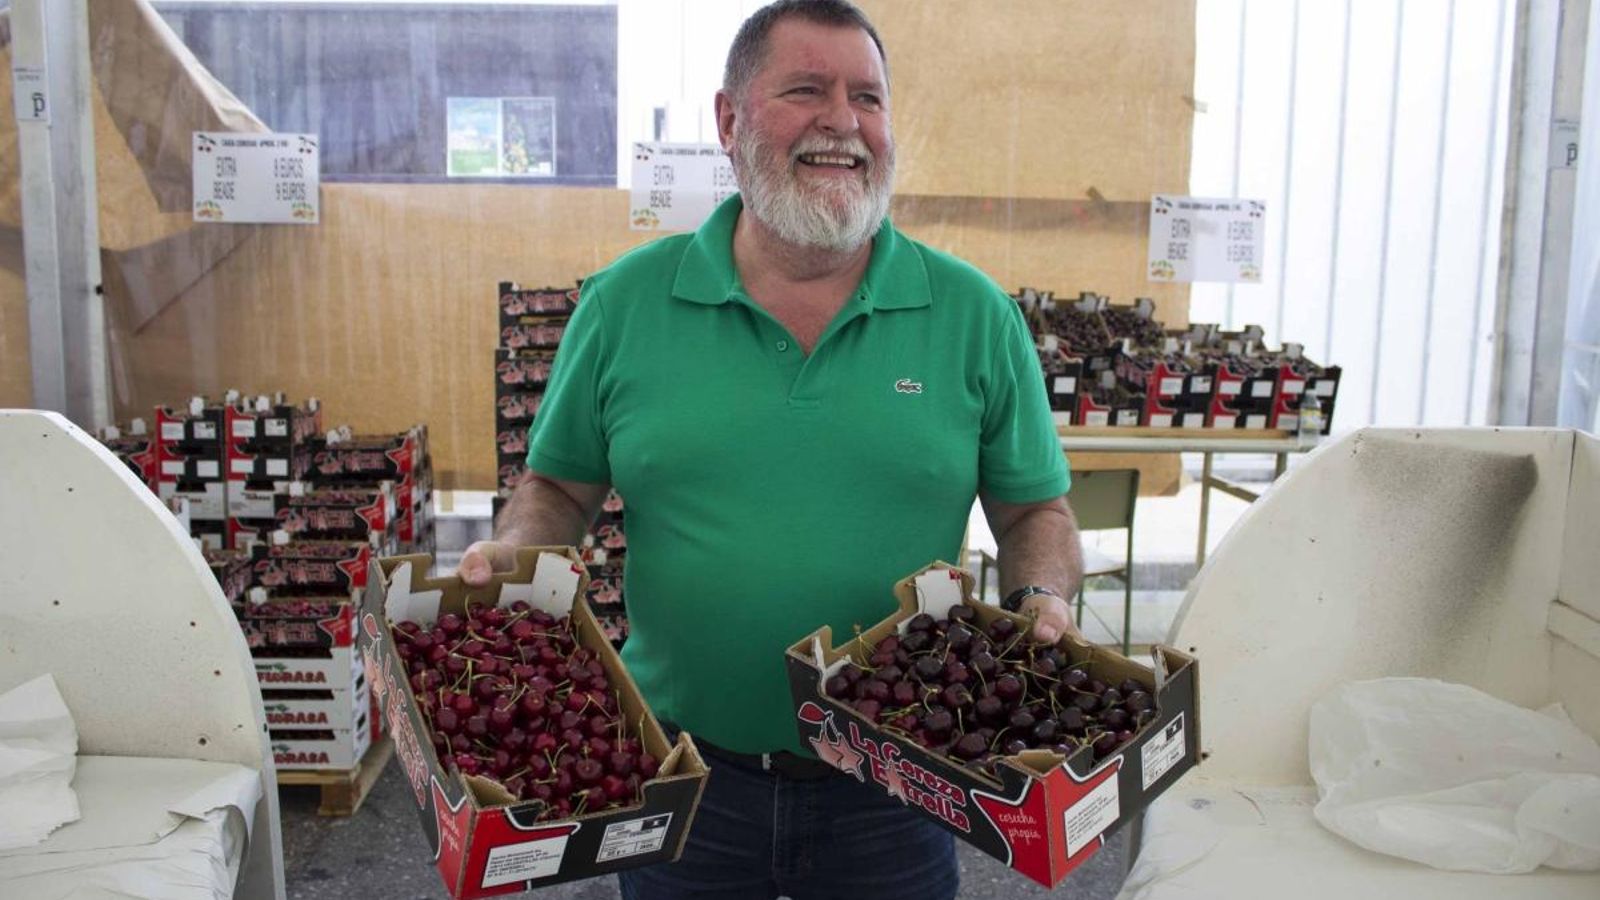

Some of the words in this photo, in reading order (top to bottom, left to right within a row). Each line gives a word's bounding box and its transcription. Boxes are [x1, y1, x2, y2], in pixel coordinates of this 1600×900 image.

[849, 721, 880, 757] La
[881, 741, 968, 808] Cereza
[869, 755, 972, 833] Etrella
[998, 808, 1038, 825] cosecha
[1008, 827, 1041, 846] propia
